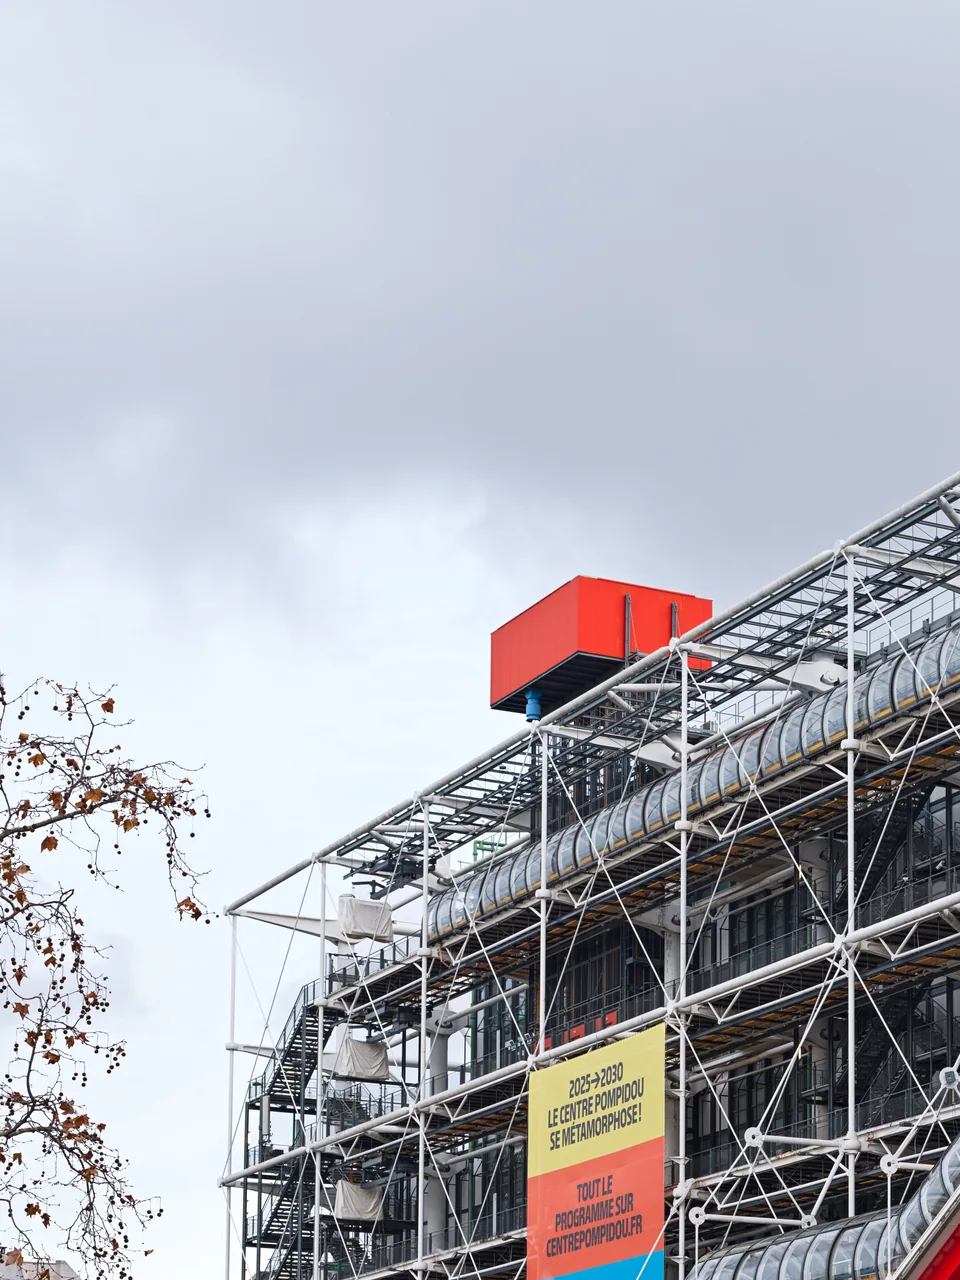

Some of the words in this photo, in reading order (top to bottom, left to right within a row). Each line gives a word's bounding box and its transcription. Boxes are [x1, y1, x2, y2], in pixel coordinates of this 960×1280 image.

[548, 1107, 558, 1128] LE
[560, 1096, 593, 1124] CENTRE
[594, 1077, 644, 1113] POMPIDOU
[550, 1130, 560, 1151] SE
[577, 1178, 601, 1203] TOUT
[602, 1174, 613, 1196] LE
[555, 1198, 614, 1232] PROGRAMME
[615, 1192, 634, 1215] SUR
[546, 1214, 643, 1257] CENTREPOMPIDOU.FR
